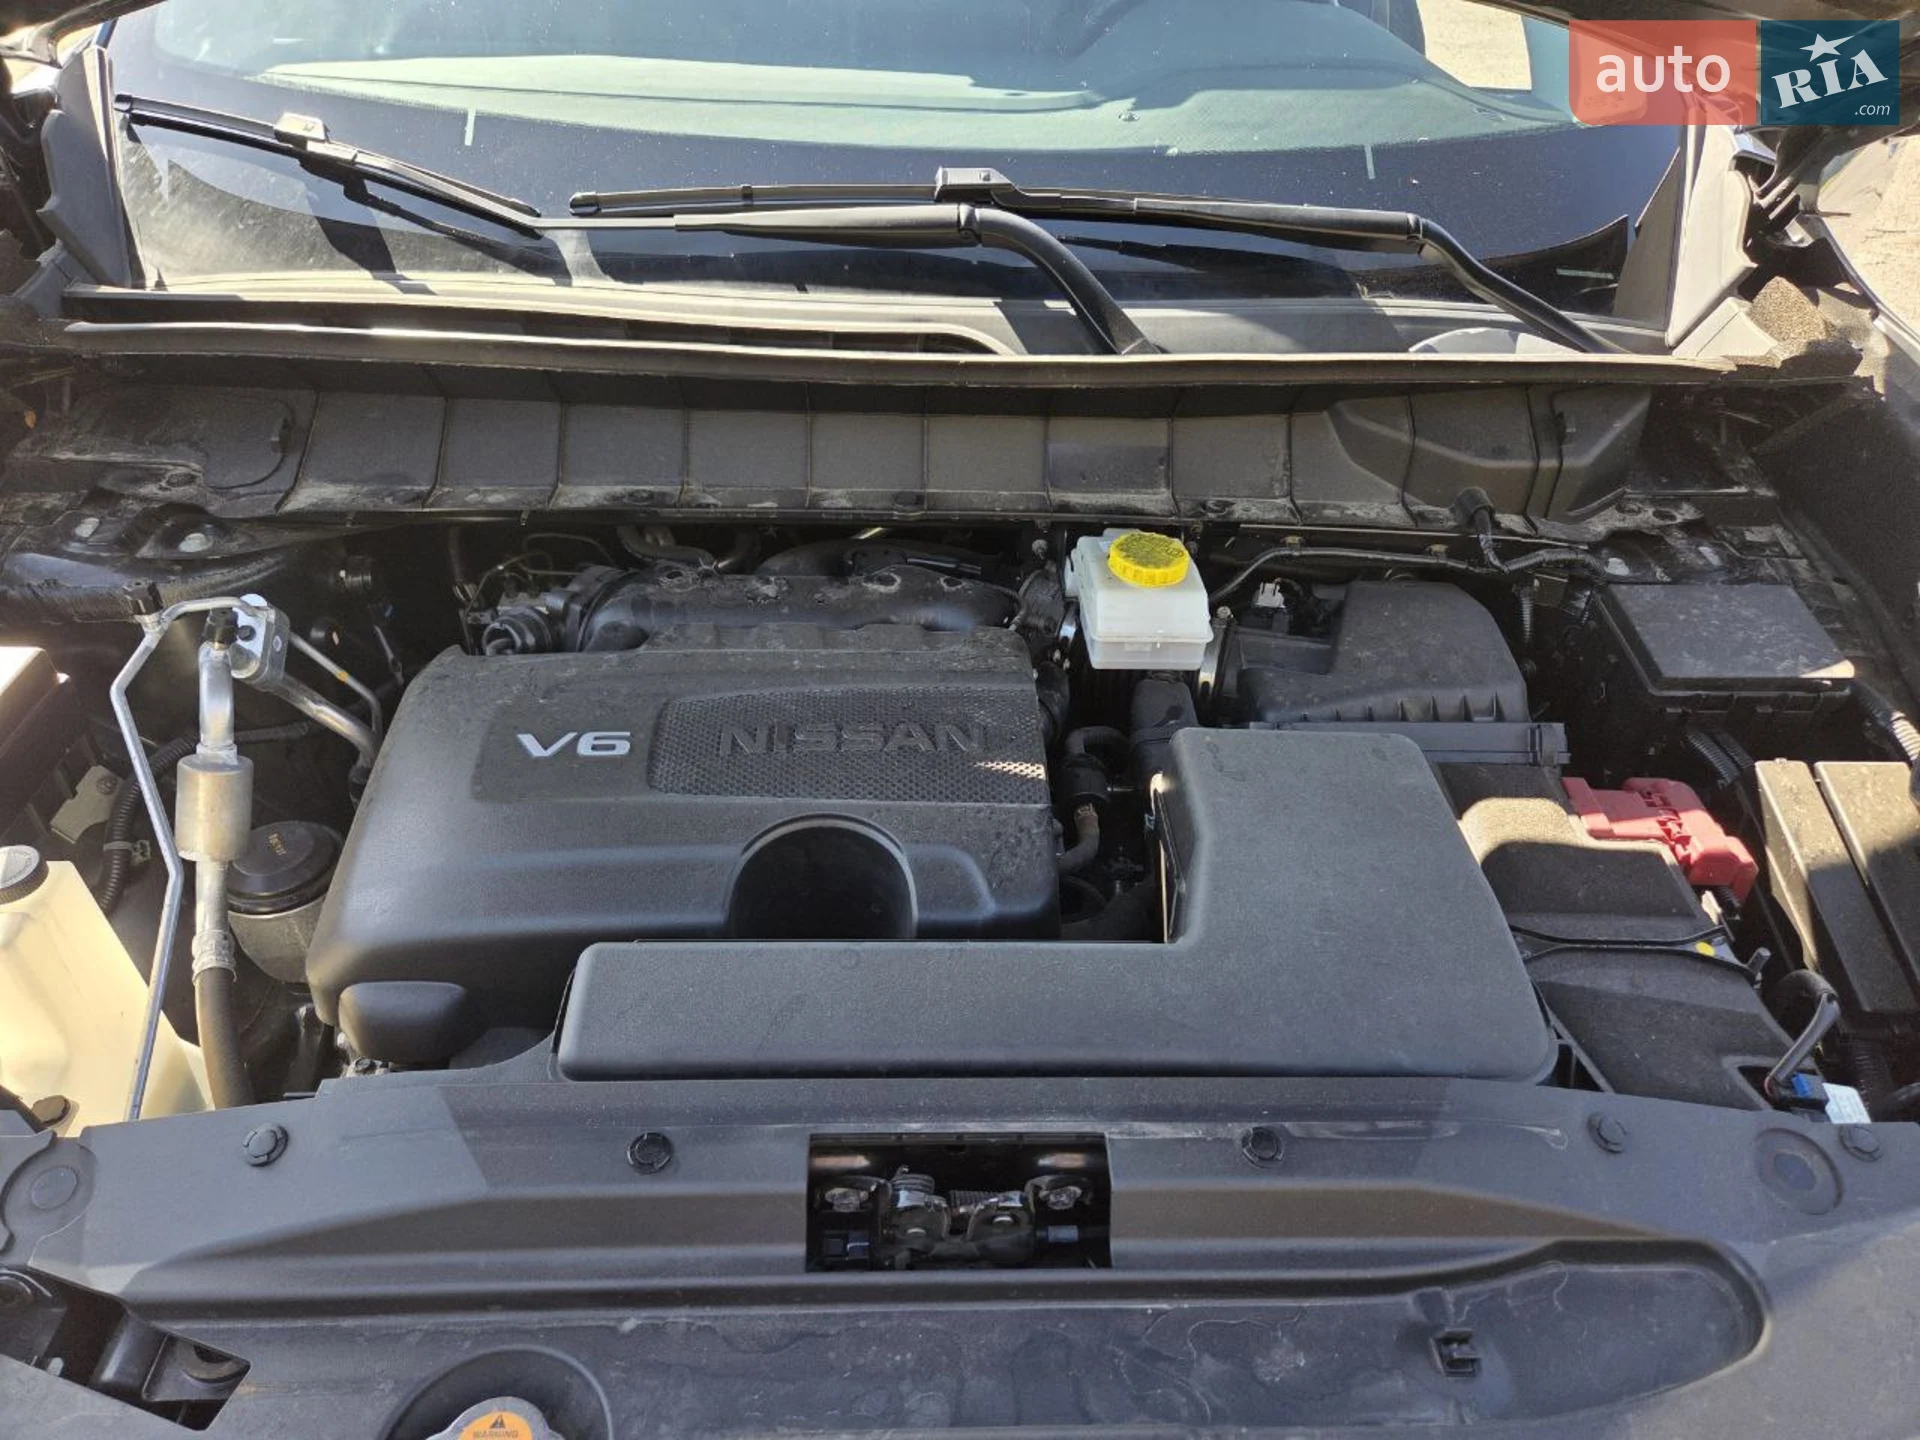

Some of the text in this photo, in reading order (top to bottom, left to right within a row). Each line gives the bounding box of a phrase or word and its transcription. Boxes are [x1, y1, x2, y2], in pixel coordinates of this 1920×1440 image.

[516, 731, 632, 758] V6
[718, 722, 987, 757] NISSAN
[473, 1430, 518, 1439] WARNING
